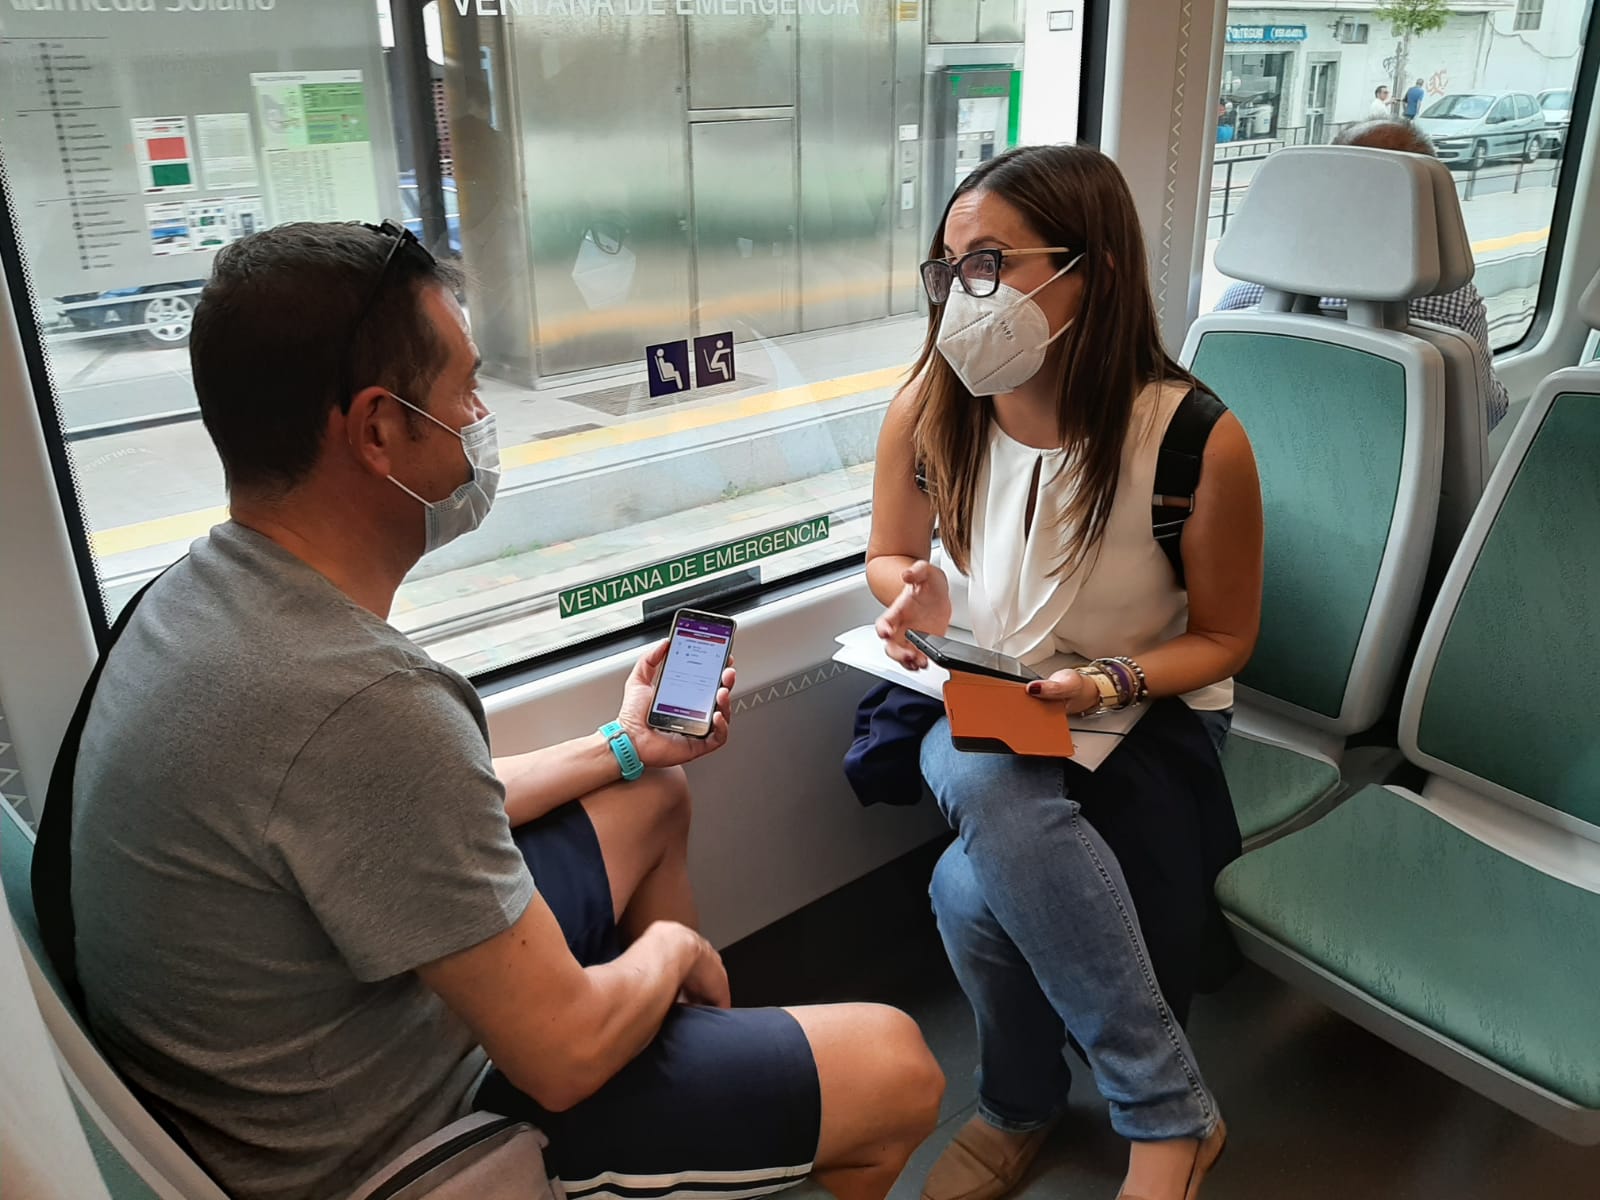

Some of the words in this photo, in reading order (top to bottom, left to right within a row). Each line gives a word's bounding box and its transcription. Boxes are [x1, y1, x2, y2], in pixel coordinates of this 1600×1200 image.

[560, 568, 663, 613] VENTANA
[669, 557, 698, 582] DE
[703, 519, 828, 572] EMERGENCIA
